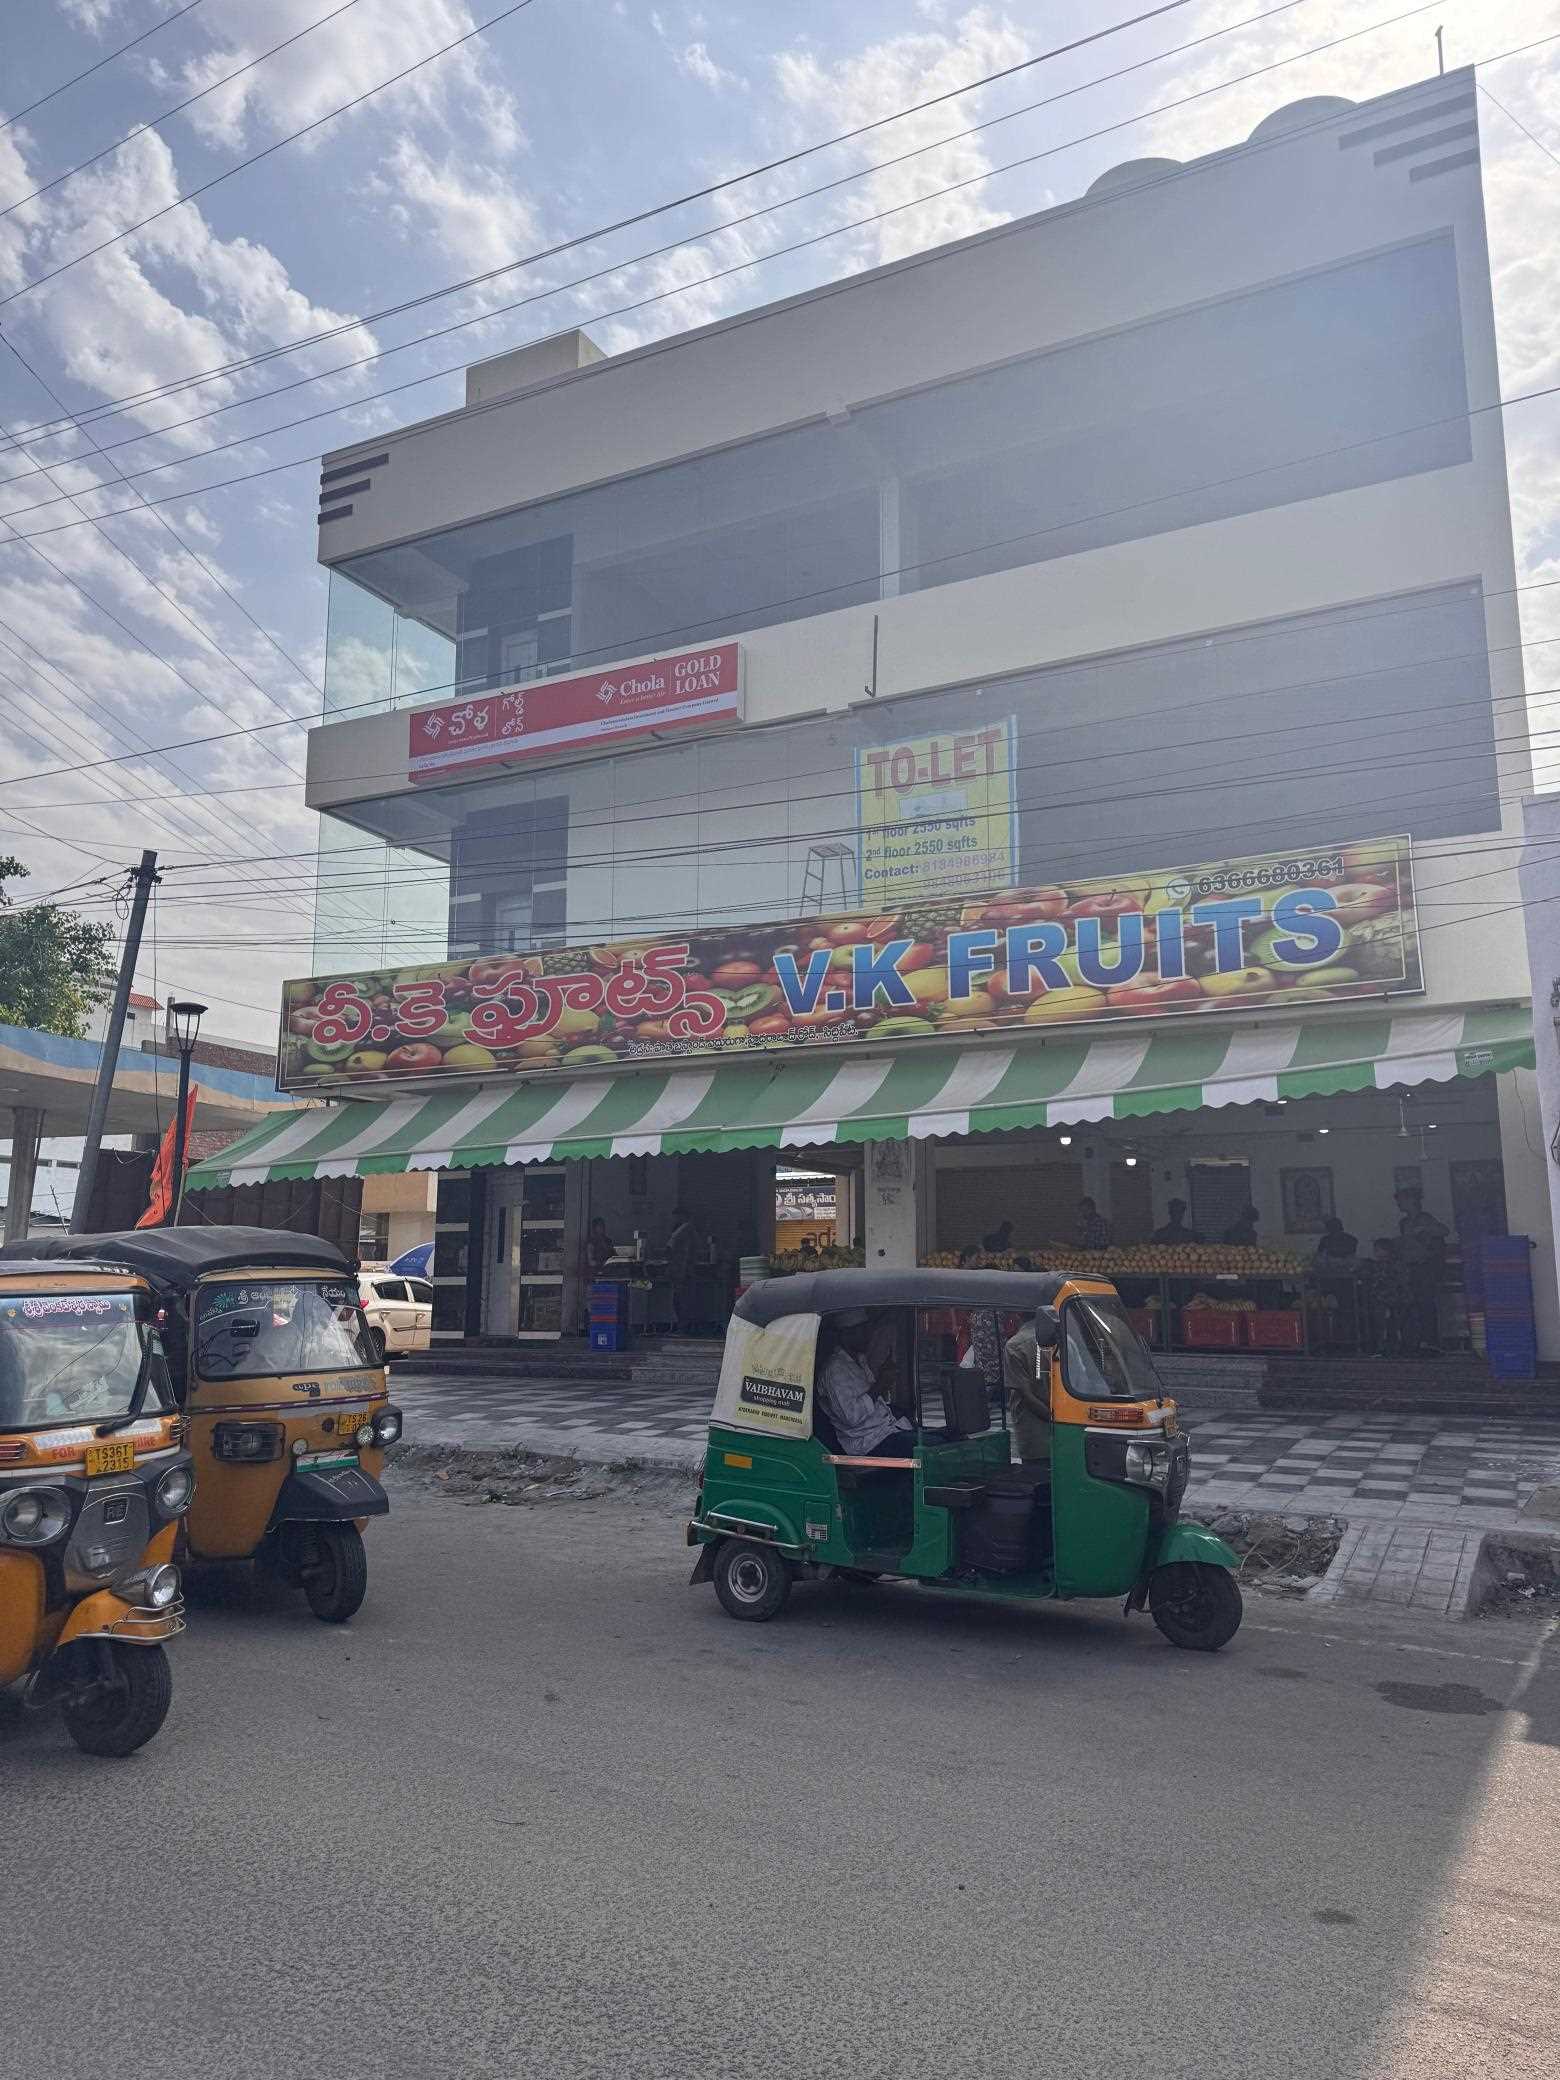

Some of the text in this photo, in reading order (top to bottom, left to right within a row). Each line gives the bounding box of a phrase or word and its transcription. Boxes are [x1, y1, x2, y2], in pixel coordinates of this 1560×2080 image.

[675, 655, 721, 677] GOLD
[620, 674, 665, 696] Chola
[675, 672, 720, 694] LOAN
[867, 728, 1001, 799] TO-LET
[866, 835, 978, 861] 2nd floor 2550 sqfts
[864, 864, 919, 880] Contact:
[773, 886, 1346, 1017] V.K FRUITS
[745, 1381, 804, 1402] VAIBHAVAM
[52, 1446, 75, 1460] FOR
[95, 1444, 129, 1461] TS36T
